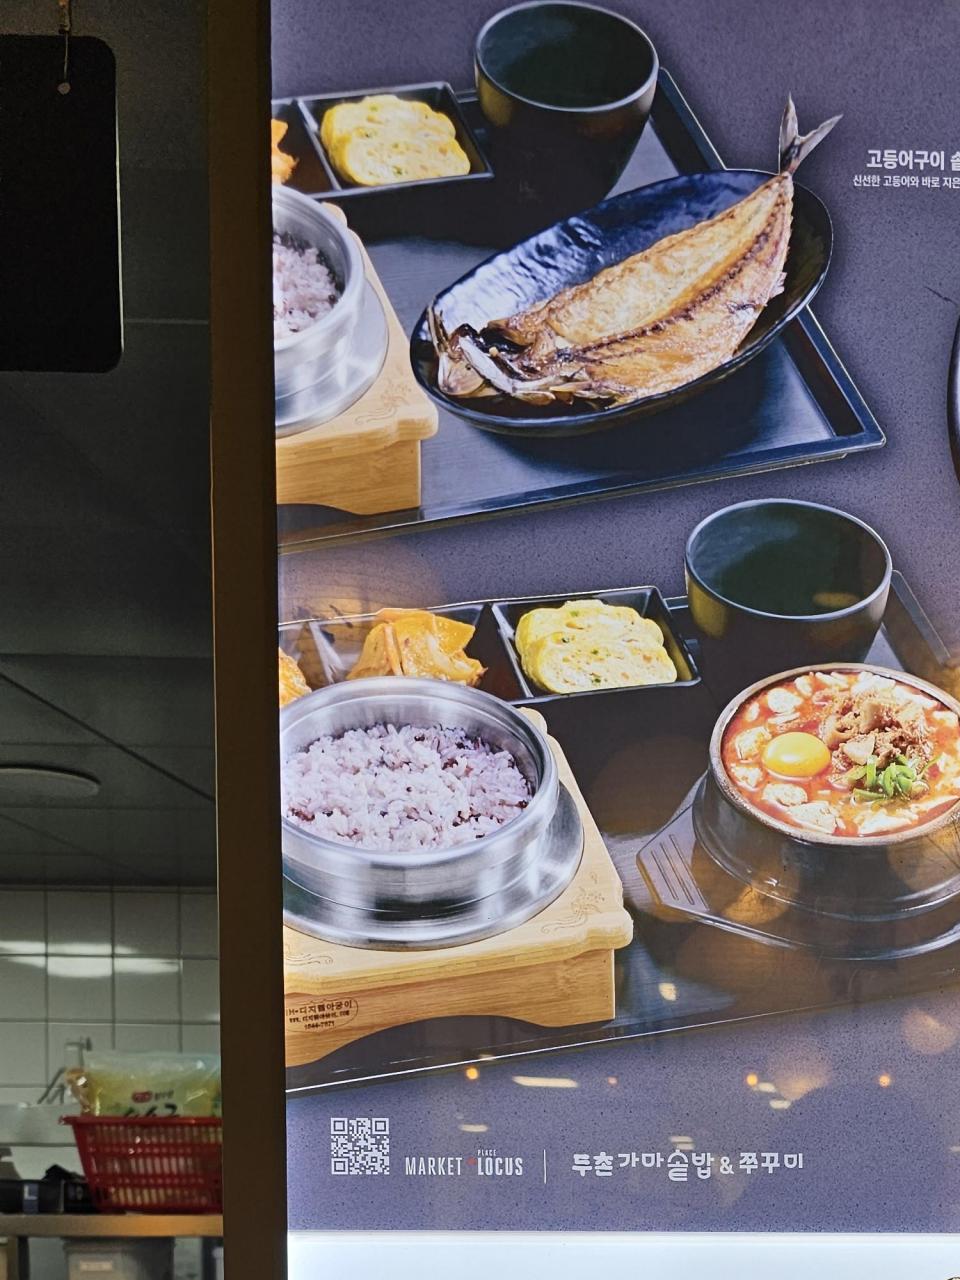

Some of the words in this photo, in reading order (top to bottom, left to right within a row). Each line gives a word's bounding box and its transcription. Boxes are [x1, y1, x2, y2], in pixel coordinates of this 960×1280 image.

[866, 149, 945, 171] 고등어구이
[853, 175, 880, 187] 신선한
[883, 176, 919, 188] 고등어와
[921, 177, 940, 188] 바로
[943, 177, 960, 188] 지은
[405, 1157, 462, 1175] MARKET
[477, 1157, 522, 1175] LOCUS
